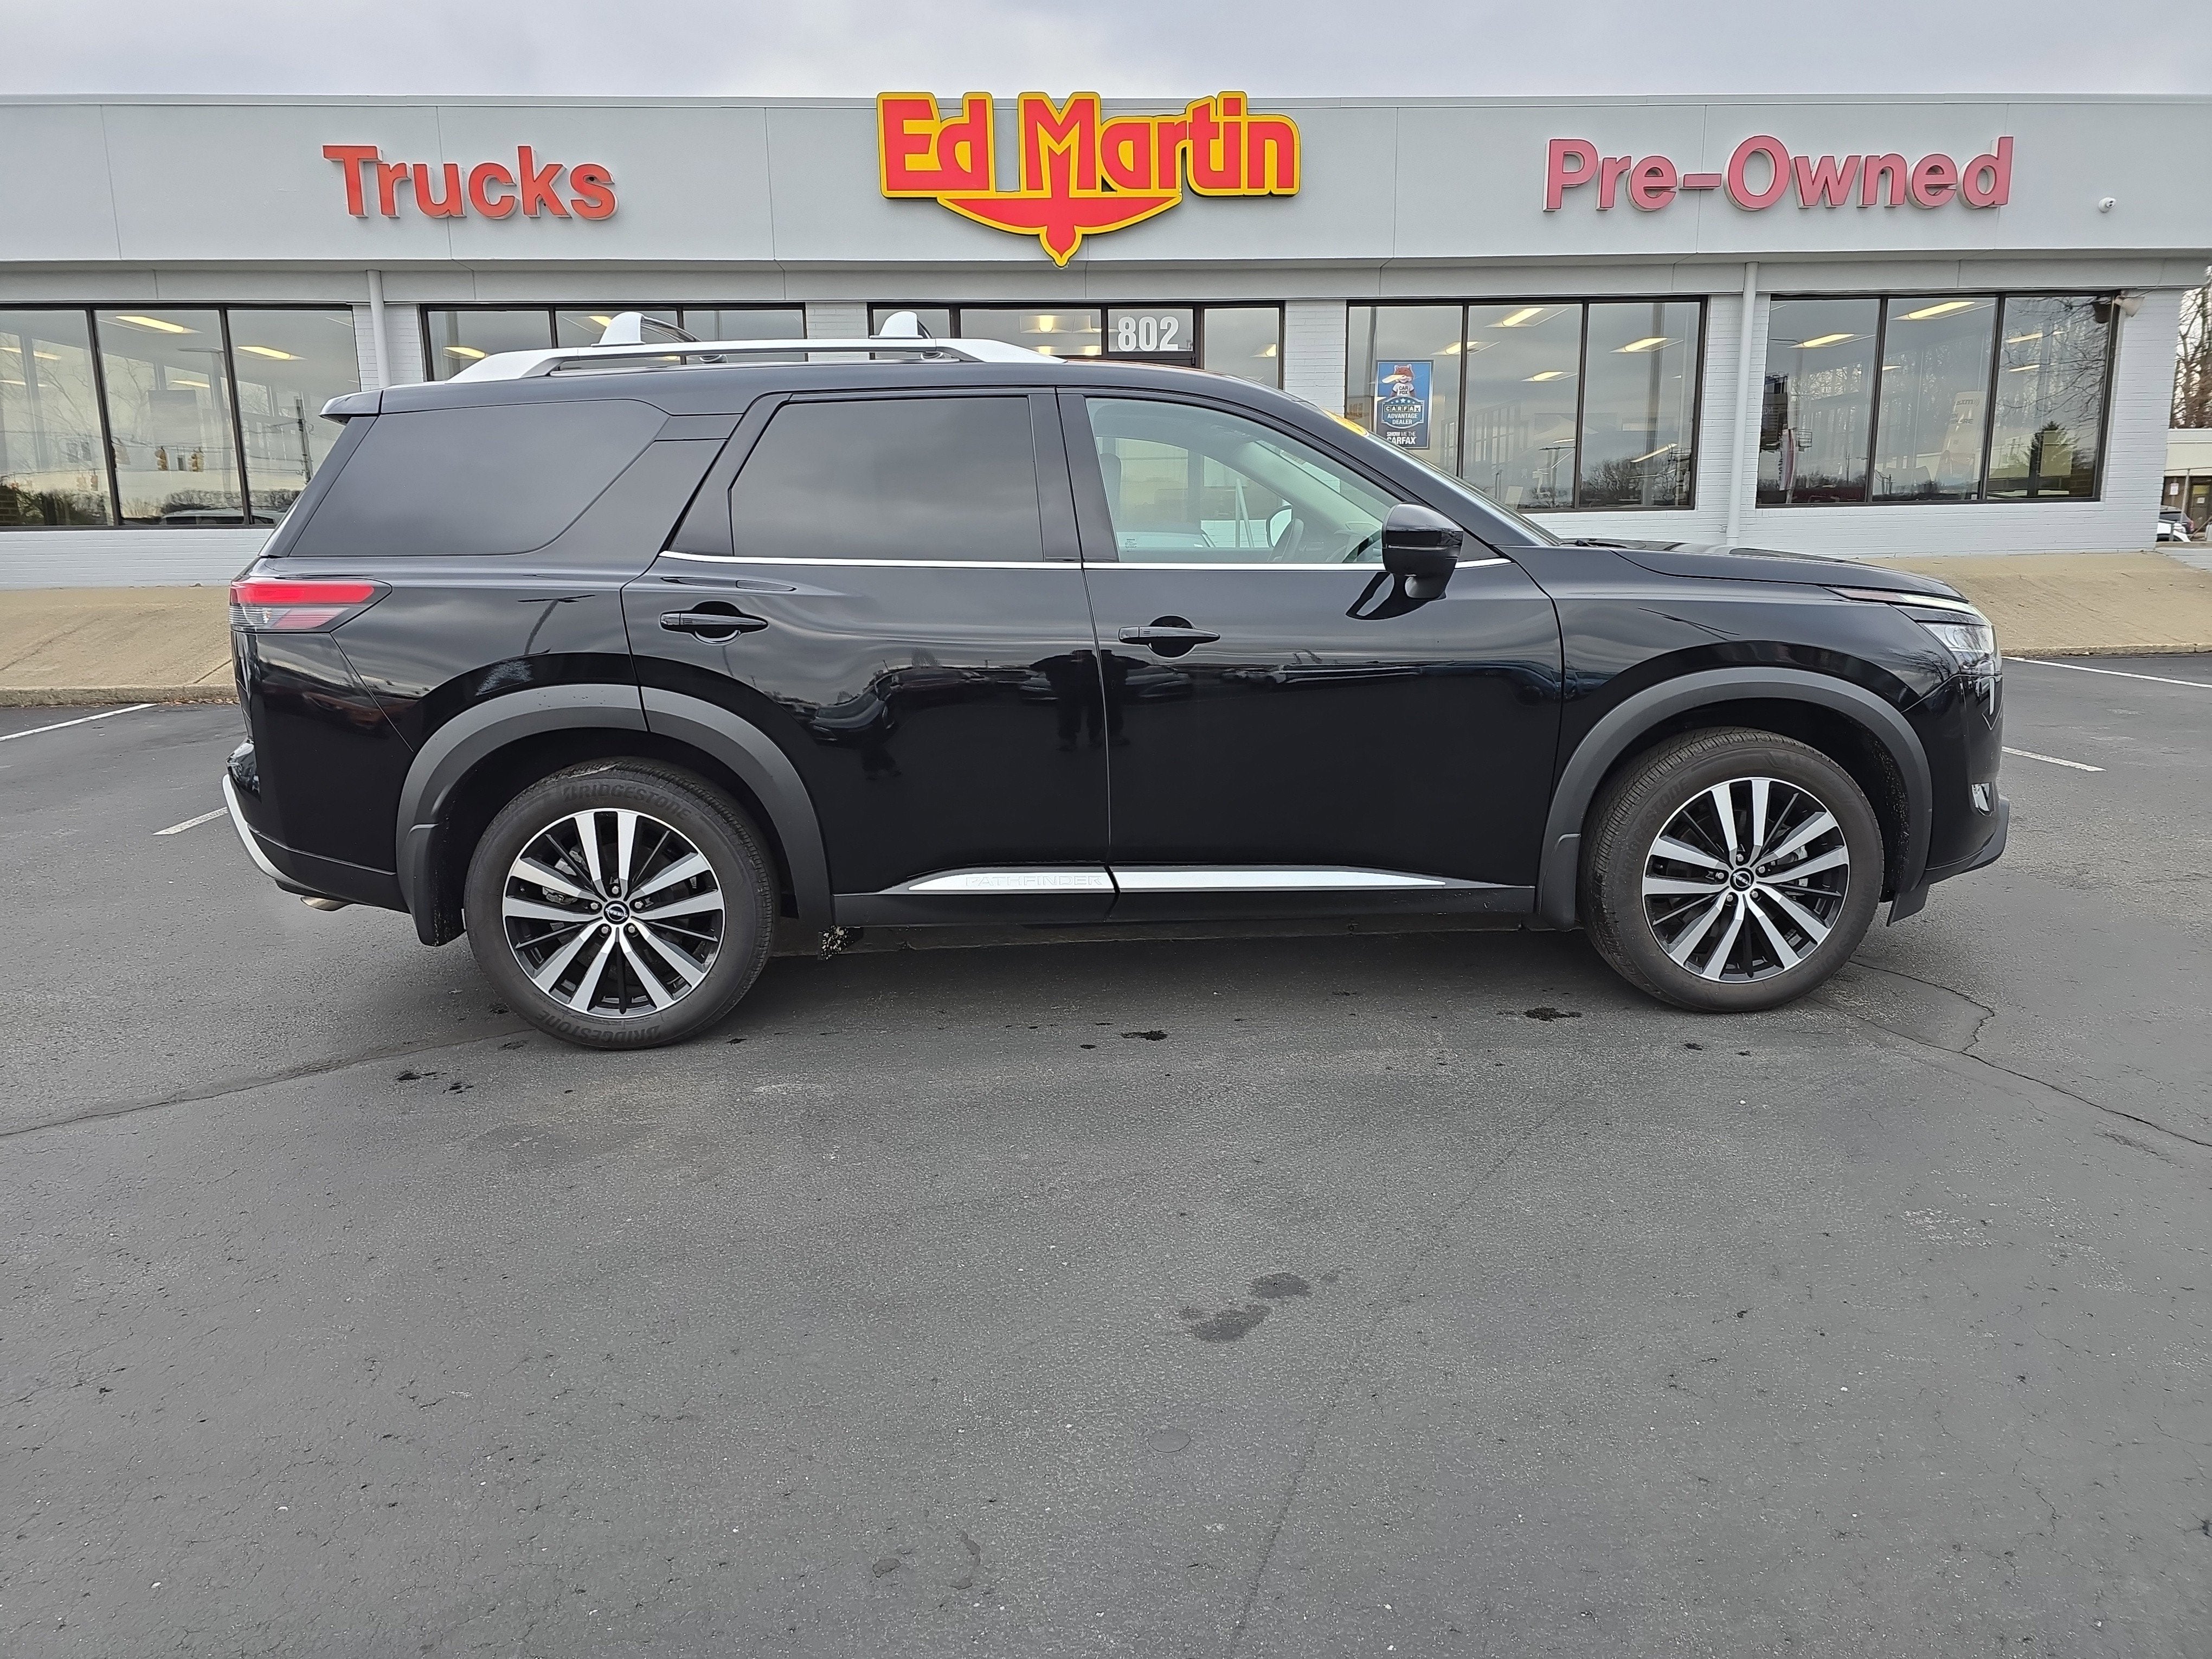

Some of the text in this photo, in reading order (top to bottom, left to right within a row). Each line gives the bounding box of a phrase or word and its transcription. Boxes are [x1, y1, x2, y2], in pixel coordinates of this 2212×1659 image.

[881, 97, 1297, 191] Ed Martin
[322, 144, 619, 220] Trucks
[1543, 135, 2014, 212] Pre-Owned
[1118, 316, 1179, 351] 802
[563, 784, 693, 820] BRIDGESTONE
[966, 876, 1103, 886] PATHFINDER
[538, 1009, 661, 1042] BRIDGESTONE
